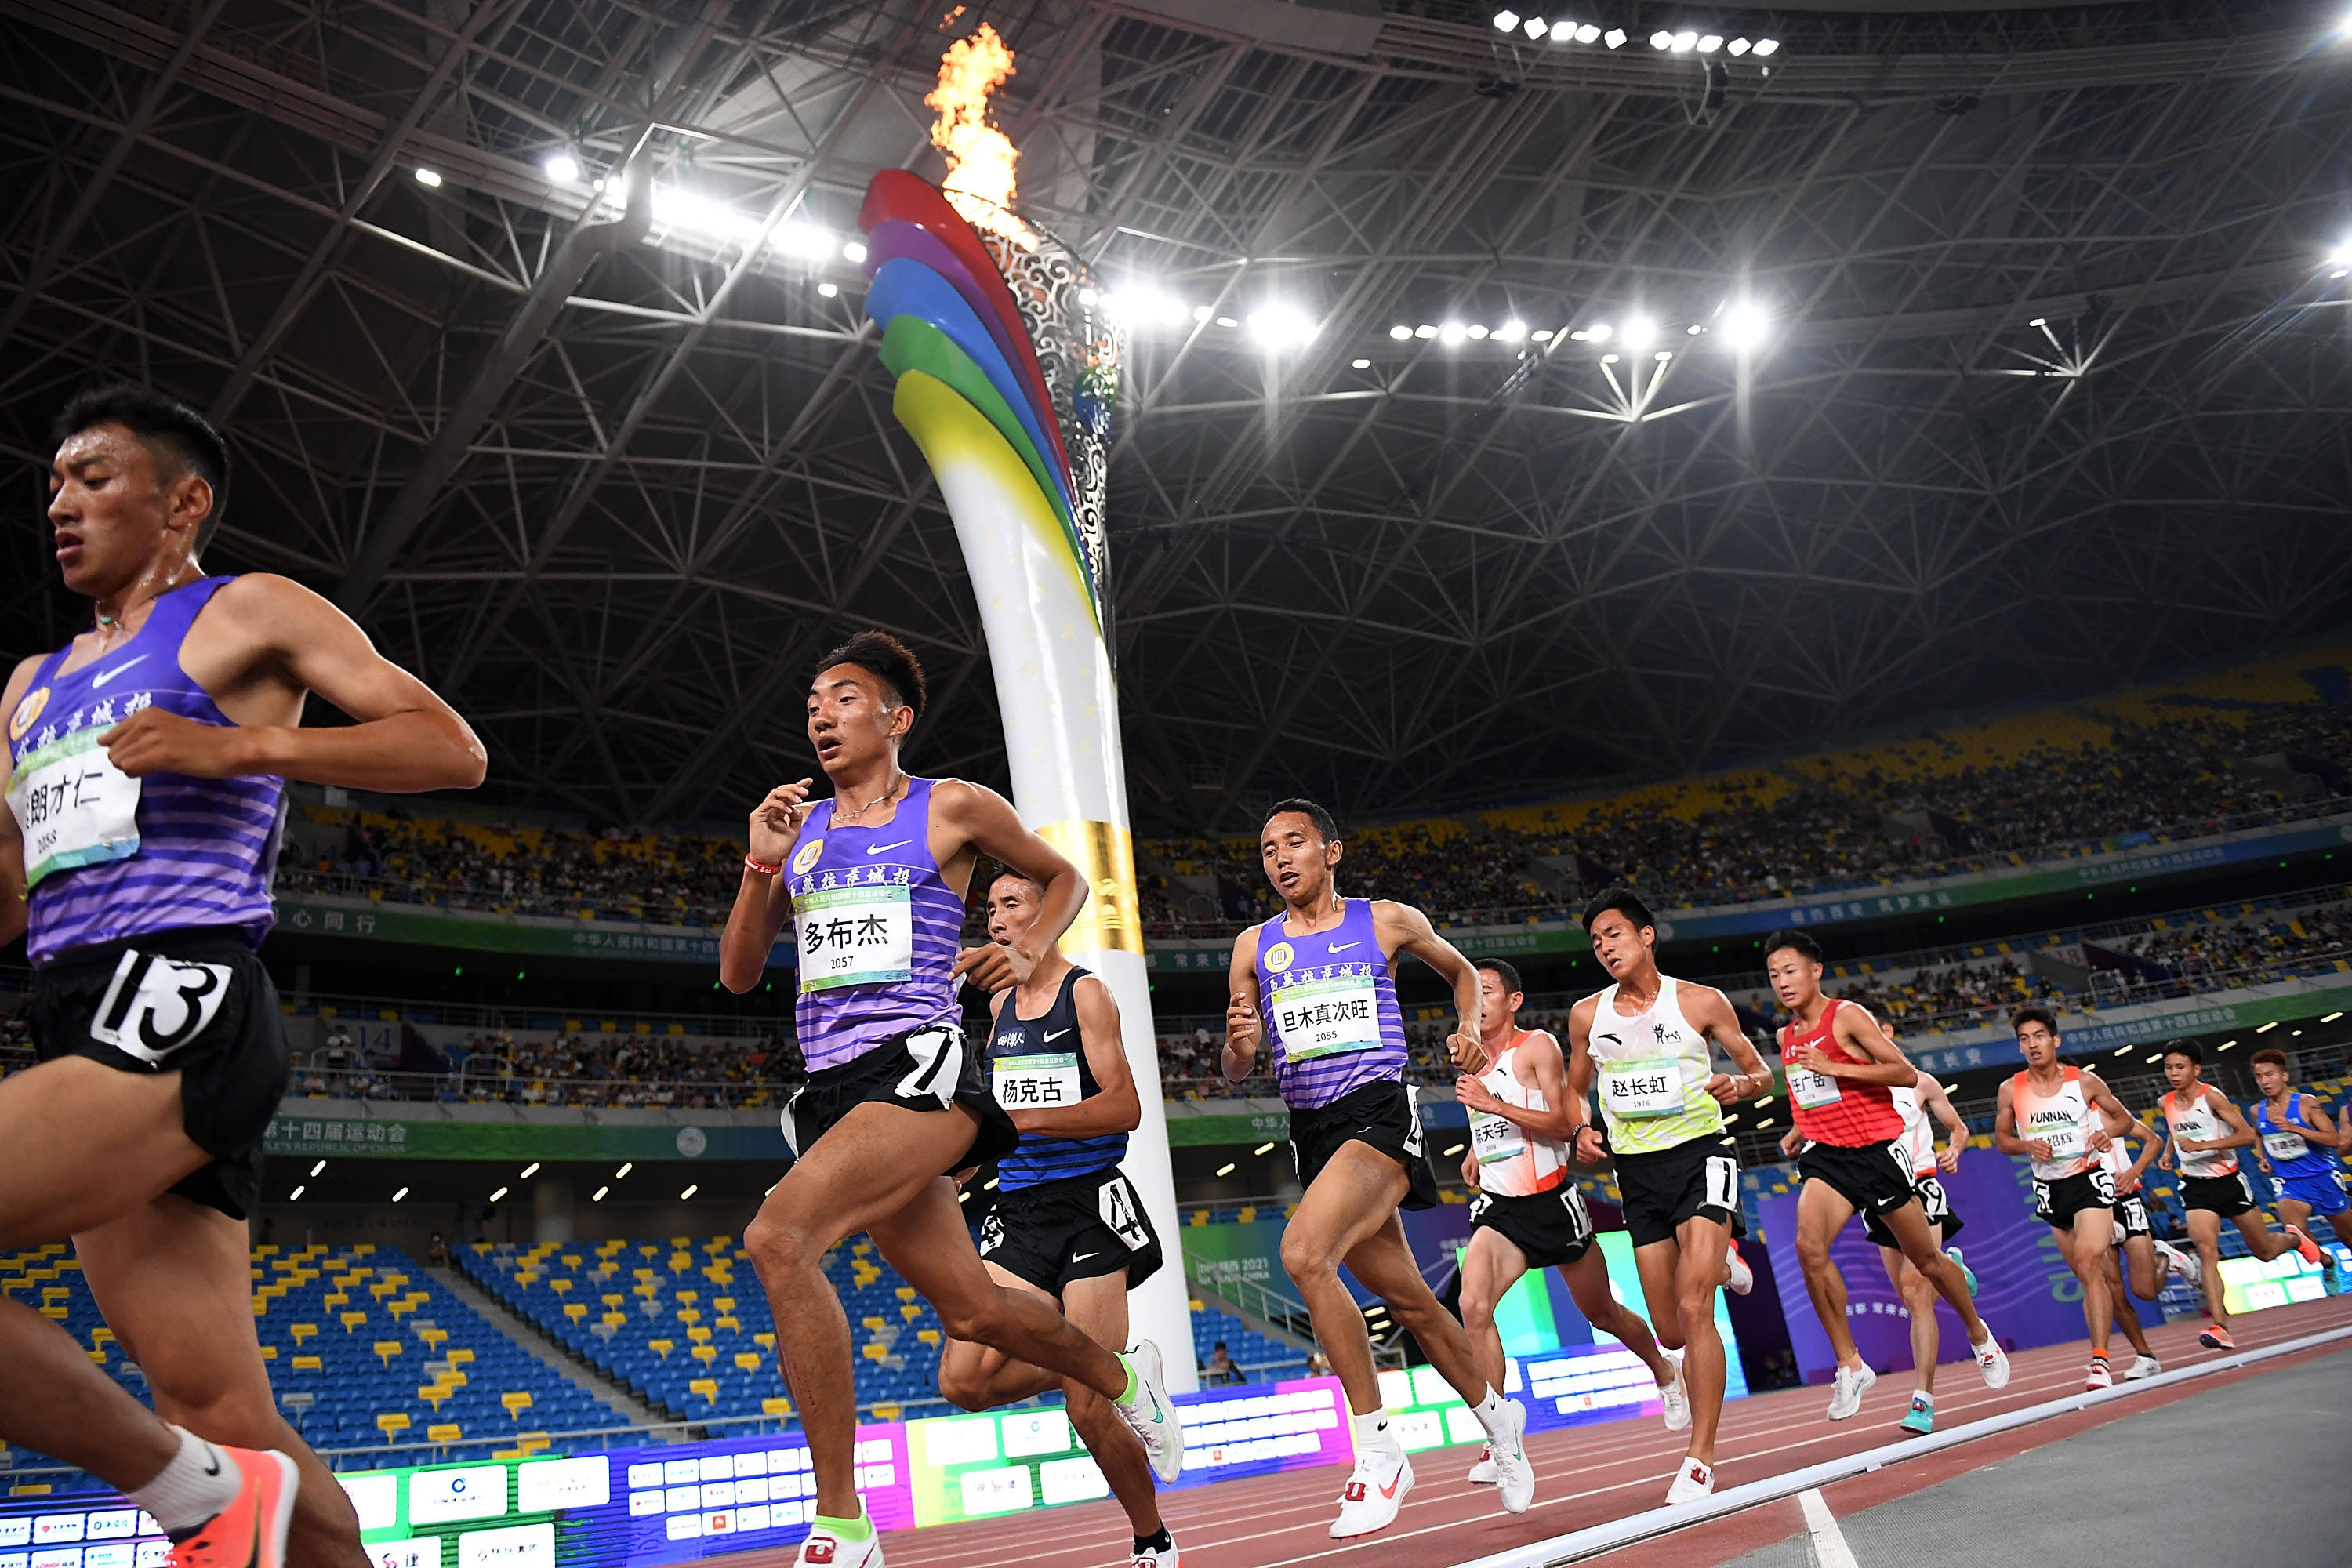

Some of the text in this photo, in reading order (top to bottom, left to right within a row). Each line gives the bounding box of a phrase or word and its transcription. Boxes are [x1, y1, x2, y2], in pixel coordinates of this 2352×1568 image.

[573, 933, 720, 955] 中华人民共和国第十四
[804, 913, 888, 955] 多布杰
[830, 956, 854, 970] 2057
[1269, 964, 1372, 991] 西藏拉萨城投
[103, 960, 218, 1052] 13
[1283, 999, 1370, 1033] 旦木真次旺
[1316, 1031, 1338, 1042] 2055
[1003, 1076, 1062, 1104] 杨克古
[1612, 1076, 1669, 1098] 赵长虹
[2030, 1109, 2074, 1124] YUNNAN
[2095, 1173, 2115, 1200] 5
